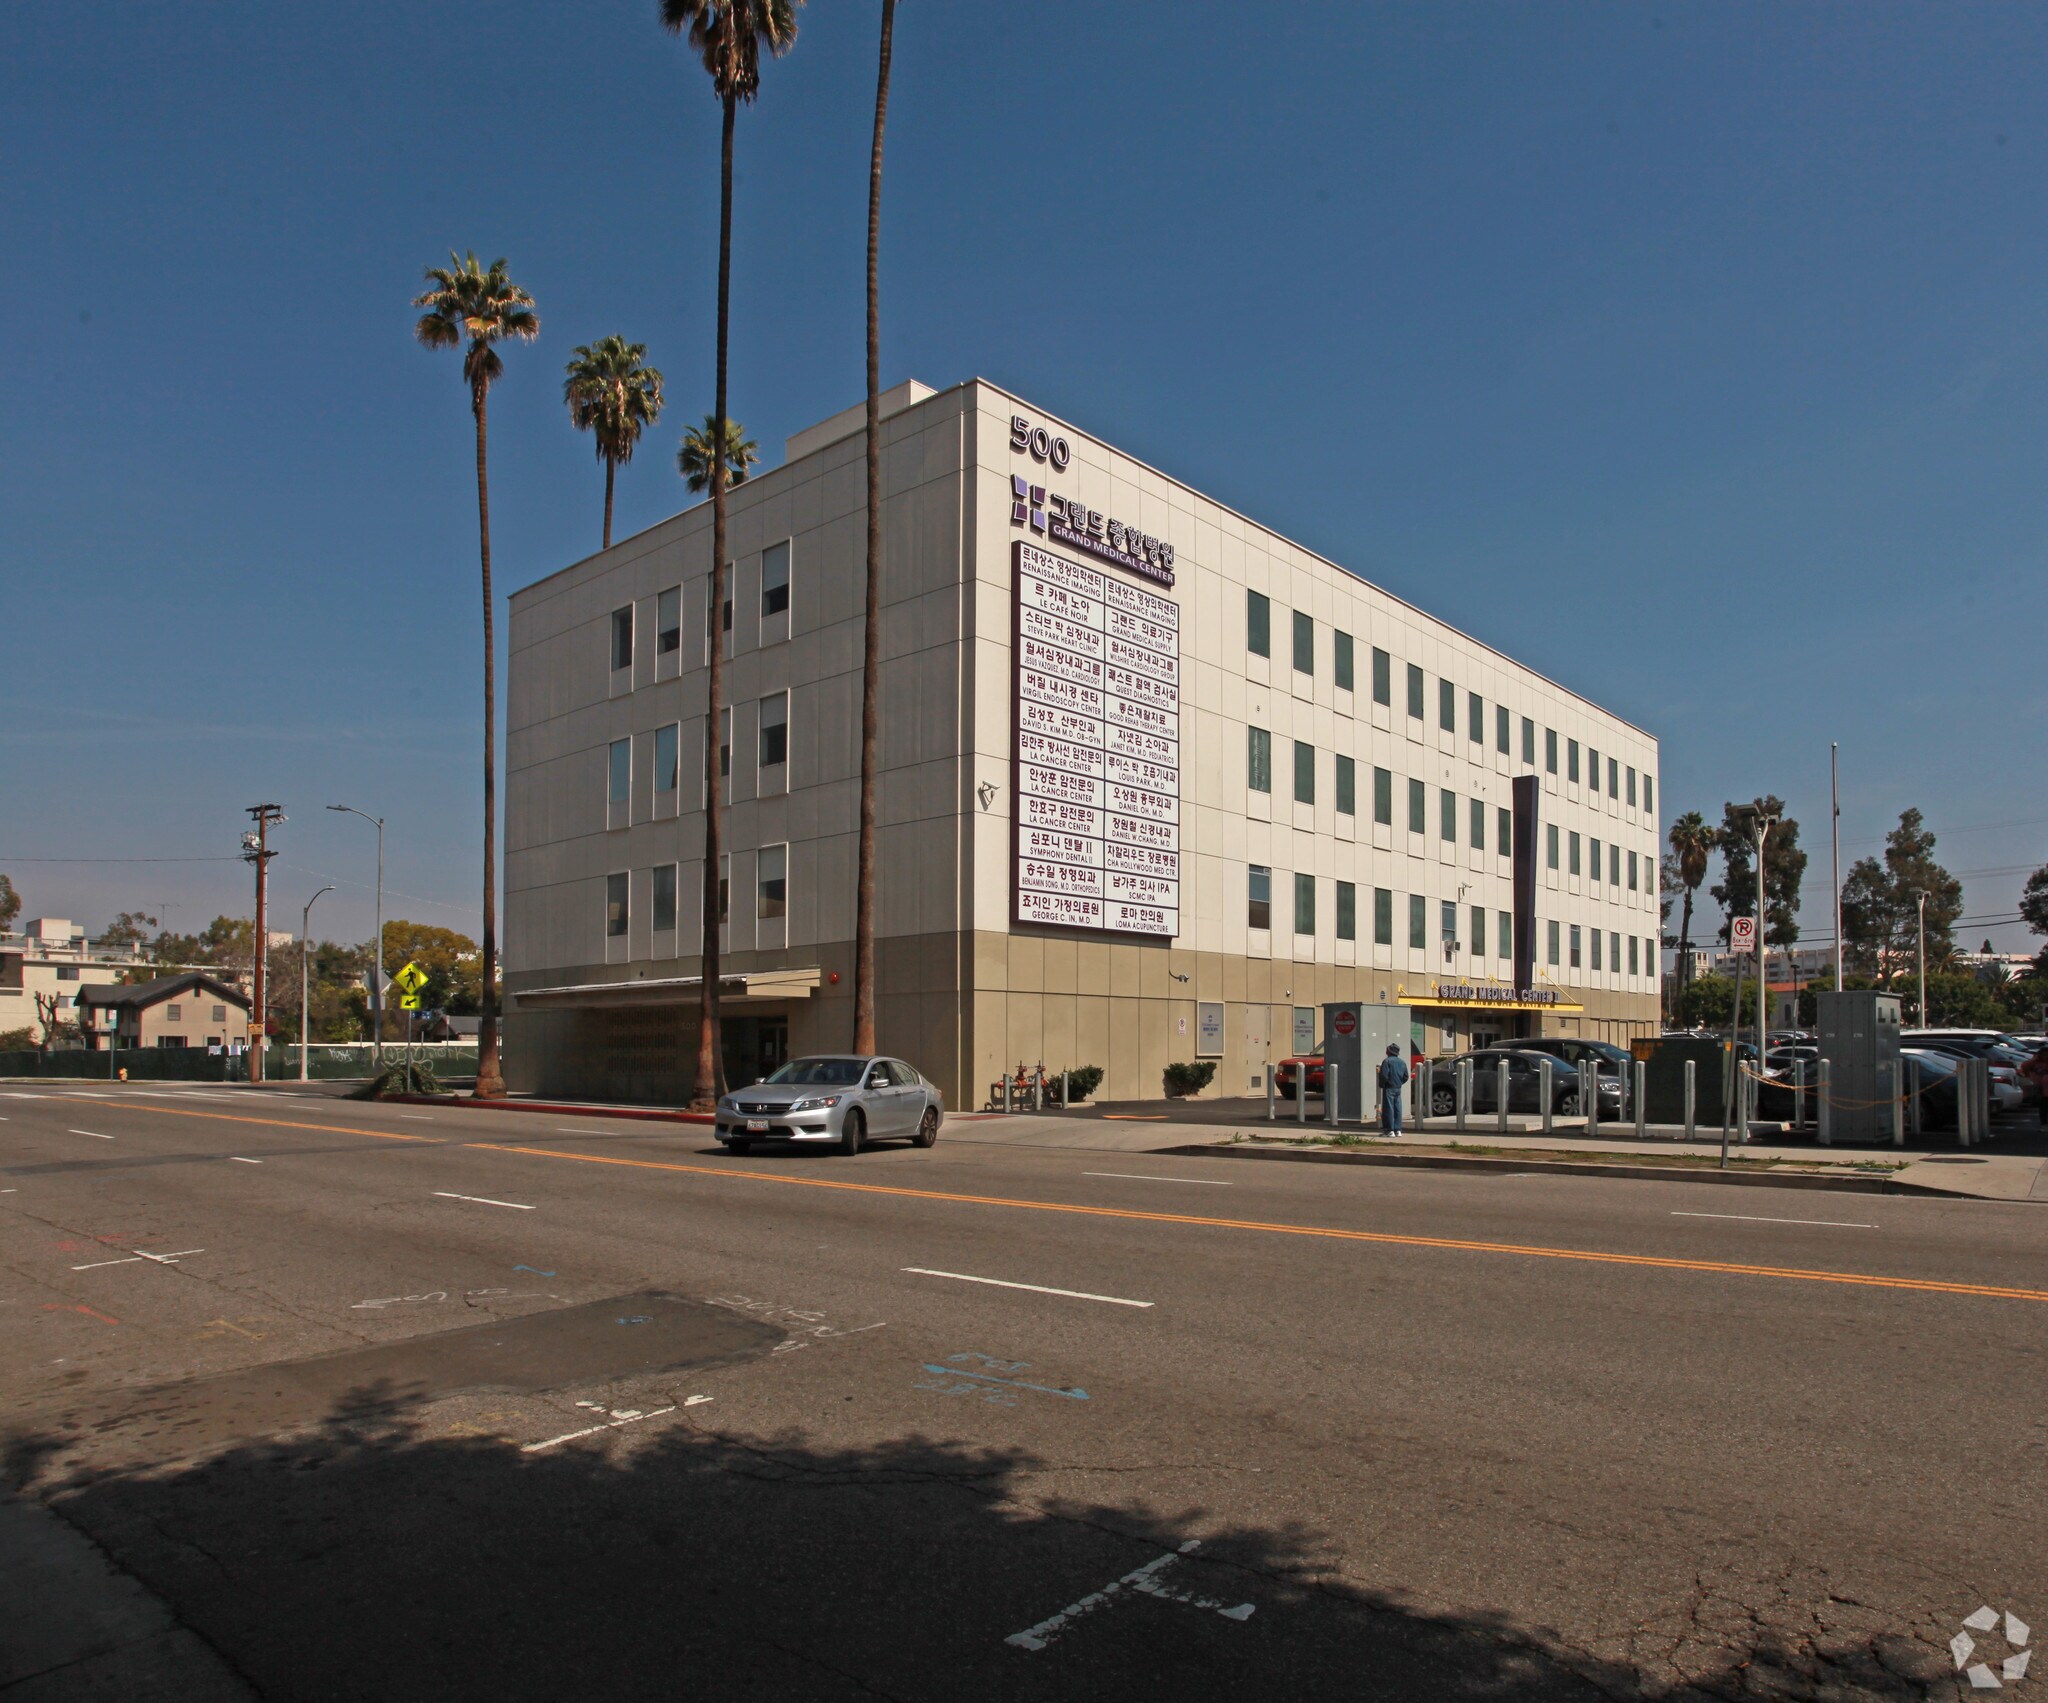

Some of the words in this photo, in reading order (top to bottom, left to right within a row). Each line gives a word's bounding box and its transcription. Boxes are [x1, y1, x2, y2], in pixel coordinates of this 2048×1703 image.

[1011, 415, 1070, 467] 500
[1050, 494, 1104, 538] 그랜드
[1108, 518, 1176, 570] 종합병원
[1053, 526, 1091, 548] GRAND
[1094, 540, 1138, 567] MEDICAL
[1139, 562, 1174, 584] CENTER
[1023, 547, 1054, 569] 르네상스
[1057, 561, 1101, 588] 영상의학센터
[1023, 562, 1069, 585] RENAISSANCE
[1071, 581, 1100, 597] IMAGING
[1035, 583, 1044, 596] 르
[1048, 588, 1067, 605] 카페
[1071, 597, 1090, 613] 노아
[1108, 582, 1135, 601] 르네상스
[1138, 593, 1176, 618] 영상의학센터
[1040, 599, 1047, 608] LE
[1050, 602, 1068, 615] CAFÉ
[1070, 610, 1088, 622] NOIR
[1108, 595, 1148, 616] RENAISSANCE
[1150, 610, 1176, 626] IMAGING
[1026, 612, 1051, 629] 스티브
[1055, 621, 1063, 633] 박
[1066, 626, 1099, 646] 심장내과
[1112, 612, 1135, 630] 그랜드
[1142, 623, 1172, 643] 의료기구
[1028, 625, 1044, 636] STEVE
[1045, 631, 1059, 642] PARK
[1061, 637, 1077, 647] HEART
[1079, 642, 1097, 654] CLINIC
[1112, 626, 1130, 638] GRAND
[1132, 633, 1153, 647] MEDICAL
[1154, 641, 1171, 652] SUPPLY
[1060, 668, 1070, 676] M.D.
[1072, 671, 1100, 686] CARDIOLOGY
[1130, 660, 1159, 675] CARDIOLOGY
[1160, 670, 1175, 680] GROUP
[1027, 673, 1046, 690] 버질
[1050, 680, 1077, 699] 내시경
[1116, 685, 1132, 696] QUEST
[1134, 690, 1169, 707] DIAGNOSTICS
[1136, 678, 1150, 692] 혈액
[1154, 684, 1176, 701] 검사실
[1022, 687, 1041, 698] VIRGIL
[1044, 693, 1079, 709] ENDOSCOPY
[1081, 702, 1101, 715] CENTER
[1028, 706, 1054, 723] 김성호
[1061, 715, 1095, 734] 산부인과
[1109, 712, 1124, 722] GOOD
[1125, 716, 1139, 727] REHAB
[1140, 720, 1158, 731] THERAPY
[1159, 726, 1175, 736] CENTER
[1023, 718, 1042, 729] DAVID
[1050, 725, 1060, 733] KIM
[1062, 729, 1075, 738] M.D.
[1077, 733, 1100, 745] OB-GYN
[1022, 735, 1045, 750] 김한주
[1048, 741, 1070, 757] 방사선
[1073, 747, 1101, 765] 암전문의
[1111, 741, 1125, 751] JANET
[1138, 748, 1148, 757] M.D.
[1149, 751, 1174, 764] PEDIATRICS
[1145, 738, 1169, 753] 소아과
[1030, 752, 1038, 760] LA
[1040, 754, 1067, 767] CANCER
[1069, 760, 1092, 772] CENTER
[1109, 756, 1129, 771] 루이스
[1132, 763, 1139, 774] 박
[1143, 765, 1176, 784] 호흡기내과
[1060, 775, 1095, 793] 암전문의
[1119, 773, 1134, 781] LOUIS
[1154, 781, 1166, 790] M.D.
[1031, 783, 1039, 791] LA
[1041, 785, 1068, 798] CANCER
[1070, 791, 1092, 803] CENTER
[1113, 787, 1137, 803] 오상원
[1060, 805, 1095, 824] 암전문의
[1119, 802, 1139, 813] DANIEL
[1152, 810, 1164, 818] M.D.
[1030, 815, 1037, 823] LA
[1040, 816, 1066, 828] CANCER
[1068, 821, 1090, 832] CENTER
[1140, 823, 1171, 838] 신경내과
[1031, 832, 1060, 848] 심포니
[1064, 837, 1083, 852] 덴탈
[1112, 830, 1130, 840] DANIEL
[1160, 839, 1172, 848] M.D.
[1030, 847, 1064, 860] SYMPHONY
[1066, 854, 1088, 863] DENTAL
[1148, 852, 1176, 868] 장로병원
[1026, 863, 1055, 879] 송수일
[1059, 867, 1096, 884] 정형외과
[1107, 859, 1119, 867] CHA
[1121, 861, 1153, 873] HOLLYWOOD
[1154, 866, 1164, 874] MED
[1022, 877, 1045, 887] BENJAMIN
[1061, 882, 1071, 891] M.D.
[1072, 883, 1100, 894] ORTHOPEDICS
[1113, 876, 1136, 890] 남가주
[1140, 880, 1155, 892] 의사
[1158, 883, 1170, 894] IPA
[1055, 898, 1099, 915] 가정의료원
[1129, 892, 1145, 901] SCMC
[1147, 894, 1155, 902] IPA
[1032, 910, 1059, 920] GEORGE
[1079, 916, 1092, 924] M.D.
[1121, 907, 1137, 920] 로마
[1140, 909, 1164, 923] 한의원
[1116, 920, 1130, 929] LOMA
[1133, 921, 1168, 933] ACUPUNCTURE
[1440, 985, 1475, 999] GRAND
[1478, 987, 1517, 1000] MEDICAL
[1521, 990, 1552, 1002] CENTER
